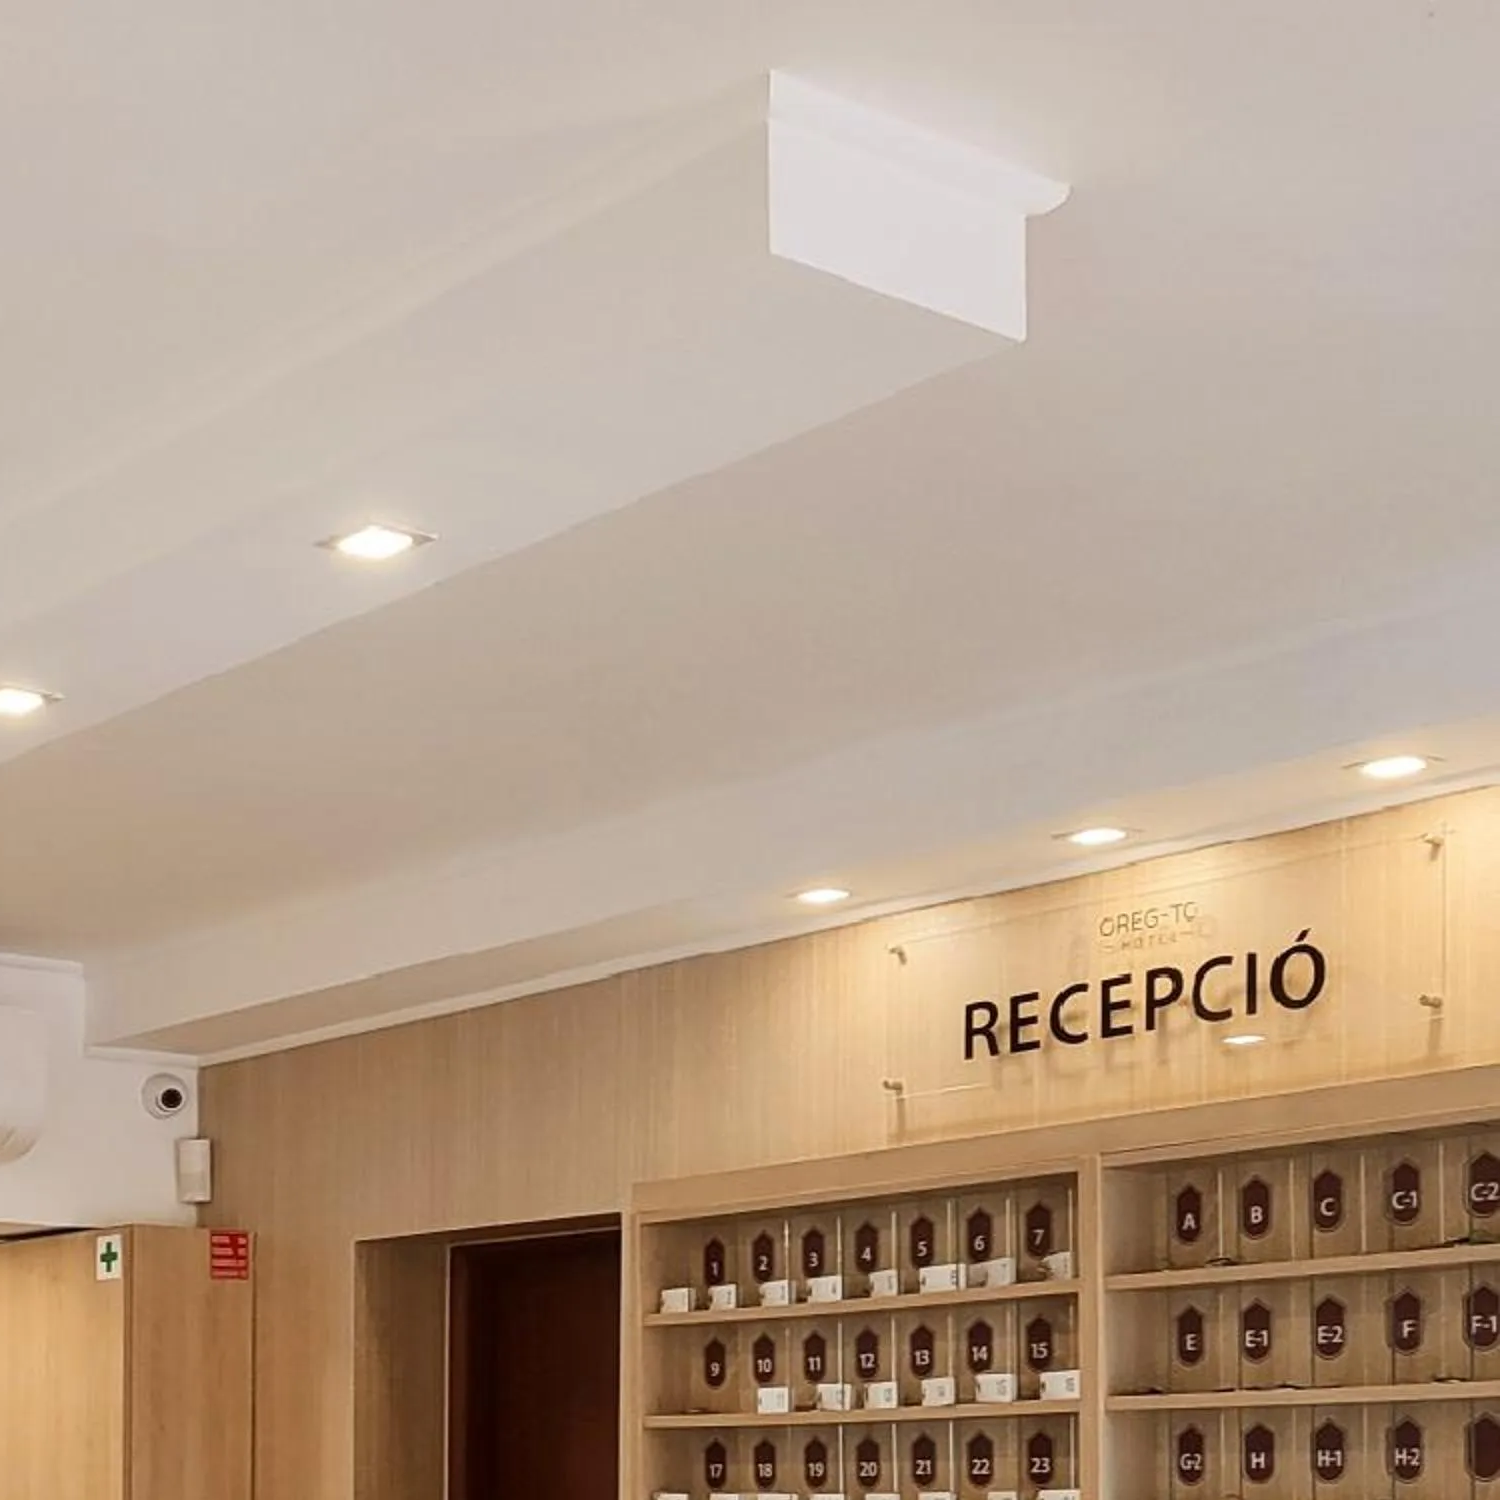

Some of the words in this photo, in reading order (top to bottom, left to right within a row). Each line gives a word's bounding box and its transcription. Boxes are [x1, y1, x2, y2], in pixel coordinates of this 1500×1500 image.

[963, 928, 1326, 1060] RECEPCIÓ
[1470, 1182, 1500, 1202] C-2
[1320, 1199, 1335, 1217] C
[1391, 1191, 1418, 1210] C-1
[1182, 1213, 1196, 1230] A
[1251, 1205, 1263, 1224] B
[974, 1235, 985, 1251] 6
[1033, 1228, 1045, 1245] 7
[861, 1247, 871, 1261] 4
[917, 1241, 927, 1257] 5
[759, 1255, 768, 1271] 2
[809, 1252, 819, 1267] 3
[711, 1262, 718, 1276] 1
[1402, 1319, 1415, 1338] F
[1471, 1315, 1497, 1333] F-1
[1185, 1333, 1196, 1351] E
[1245, 1329, 1268, 1348] E-1
[1317, 1325, 1344, 1344] E-2
[914, 1349, 930, 1365] 13
[972, 1345, 988, 1361] 14
[1031, 1342, 1048, 1359] 15
[757, 1358, 772, 1373] 10
[807, 1356, 821, 1371] 11
[859, 1353, 875, 1368] 12
[710, 1362, 720, 1377] 9
[1180, 1453, 1202, 1471] G-2
[1251, 1452, 1265, 1469] H
[1317, 1450, 1342, 1467] H-1
[1394, 1447, 1420, 1466] H-2
[709, 1463, 723, 1478] 17
[758, 1463, 773, 1477] 18
[808, 1462, 825, 1477] 19
[859, 1461, 878, 1477] 20
[915, 1459, 932, 1475] 21
[971, 1458, 990, 1475] 22
[1030, 1457, 1051, 1473] 23
